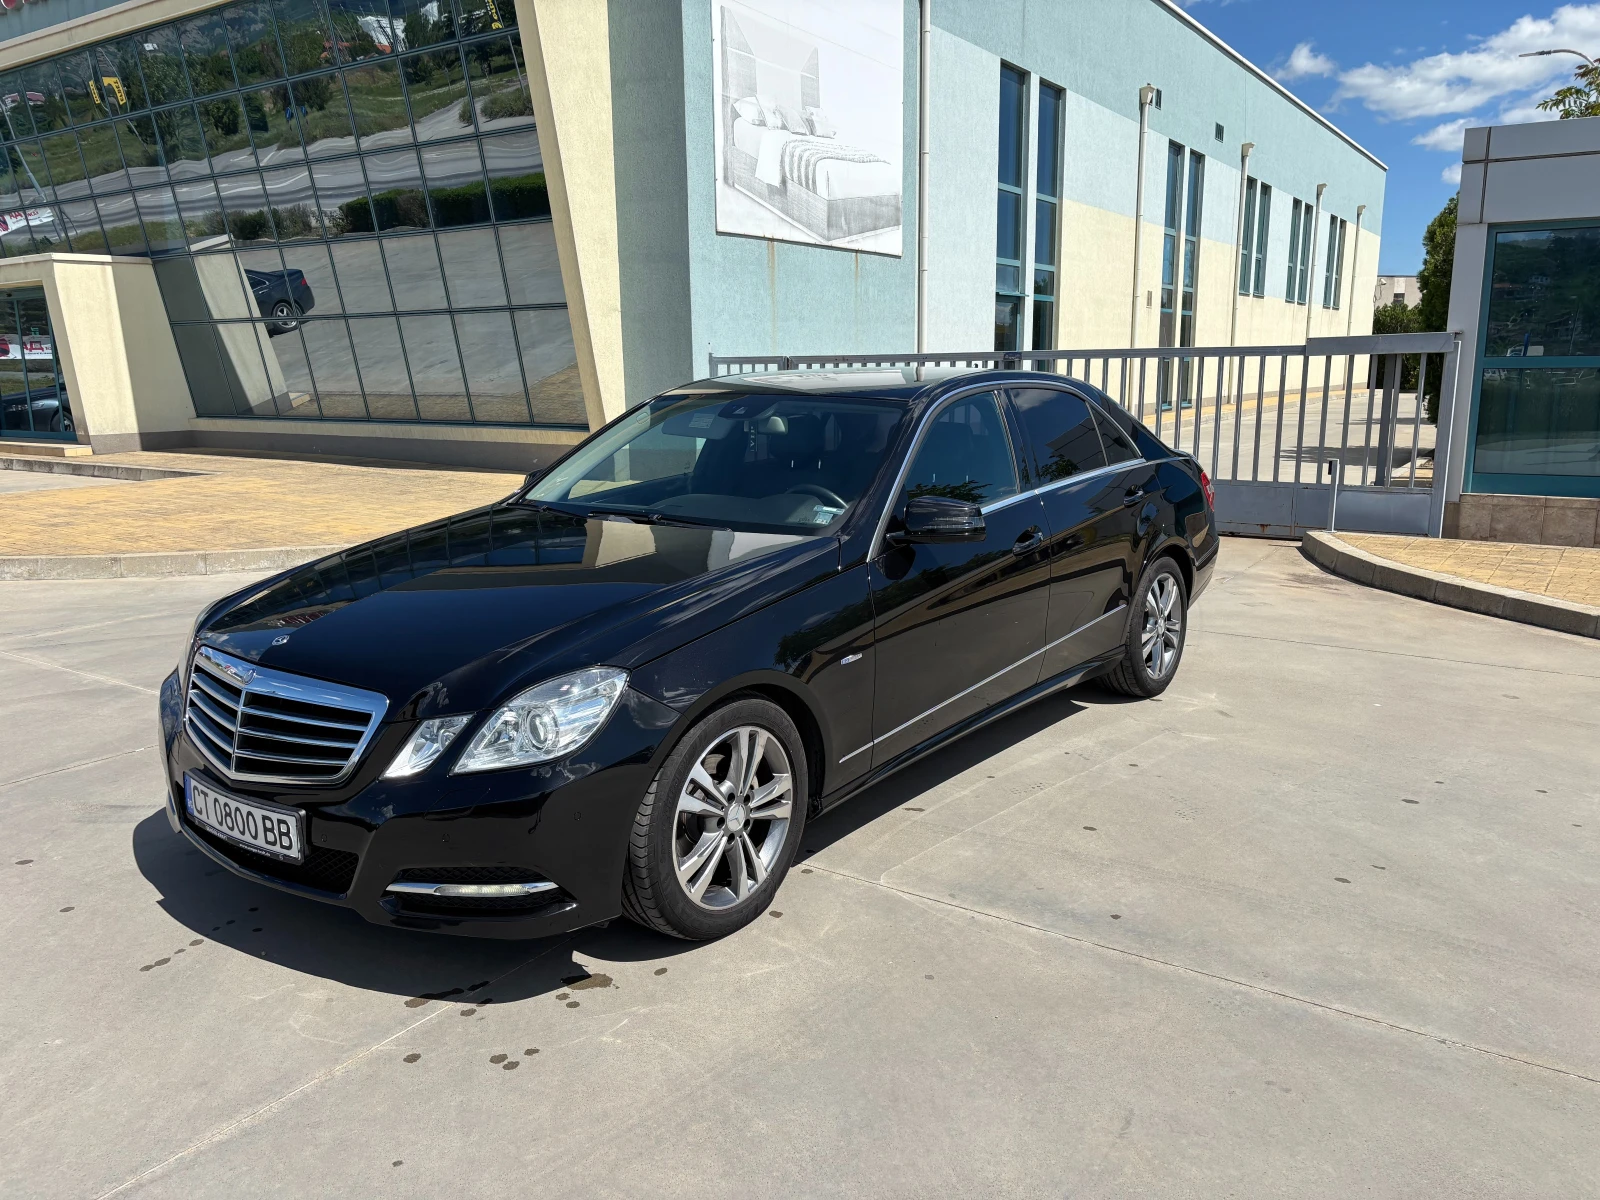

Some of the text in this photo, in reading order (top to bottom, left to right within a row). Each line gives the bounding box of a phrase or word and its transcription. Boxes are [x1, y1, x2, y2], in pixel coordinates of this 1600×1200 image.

[192, 785, 209, 820] CT
[213, 797, 258, 841] 0800
[261, 814, 293, 851] BB
